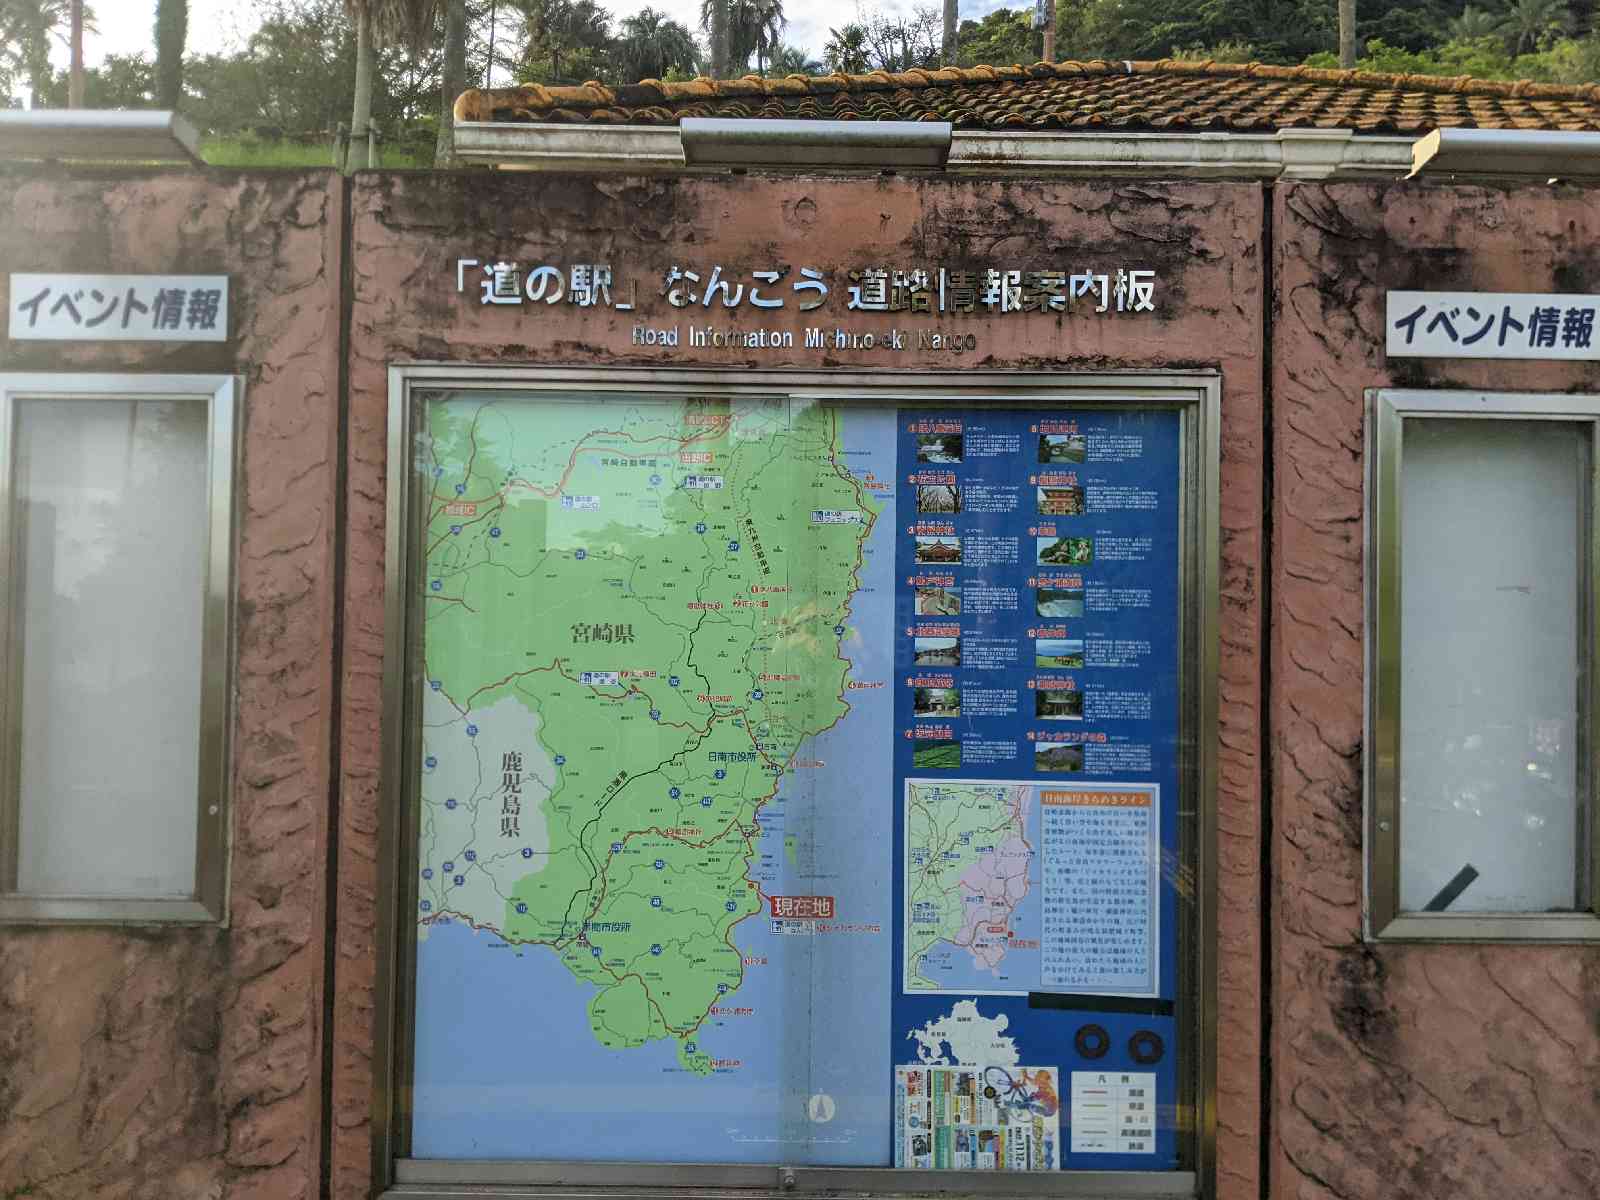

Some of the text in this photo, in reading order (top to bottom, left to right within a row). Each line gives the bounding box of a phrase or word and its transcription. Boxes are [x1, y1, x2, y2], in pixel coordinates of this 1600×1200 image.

[18, 286, 222, 330] イベント情報
[632, 326, 678, 346] Road
[1395, 304, 1595, 349] イベント情報
[571, 622, 635, 644] 宮崎県
[708, 751, 757, 762] 日南市役所
[500, 751, 523, 838] 鹿児島県
[774, 897, 832, 916] 現在地
